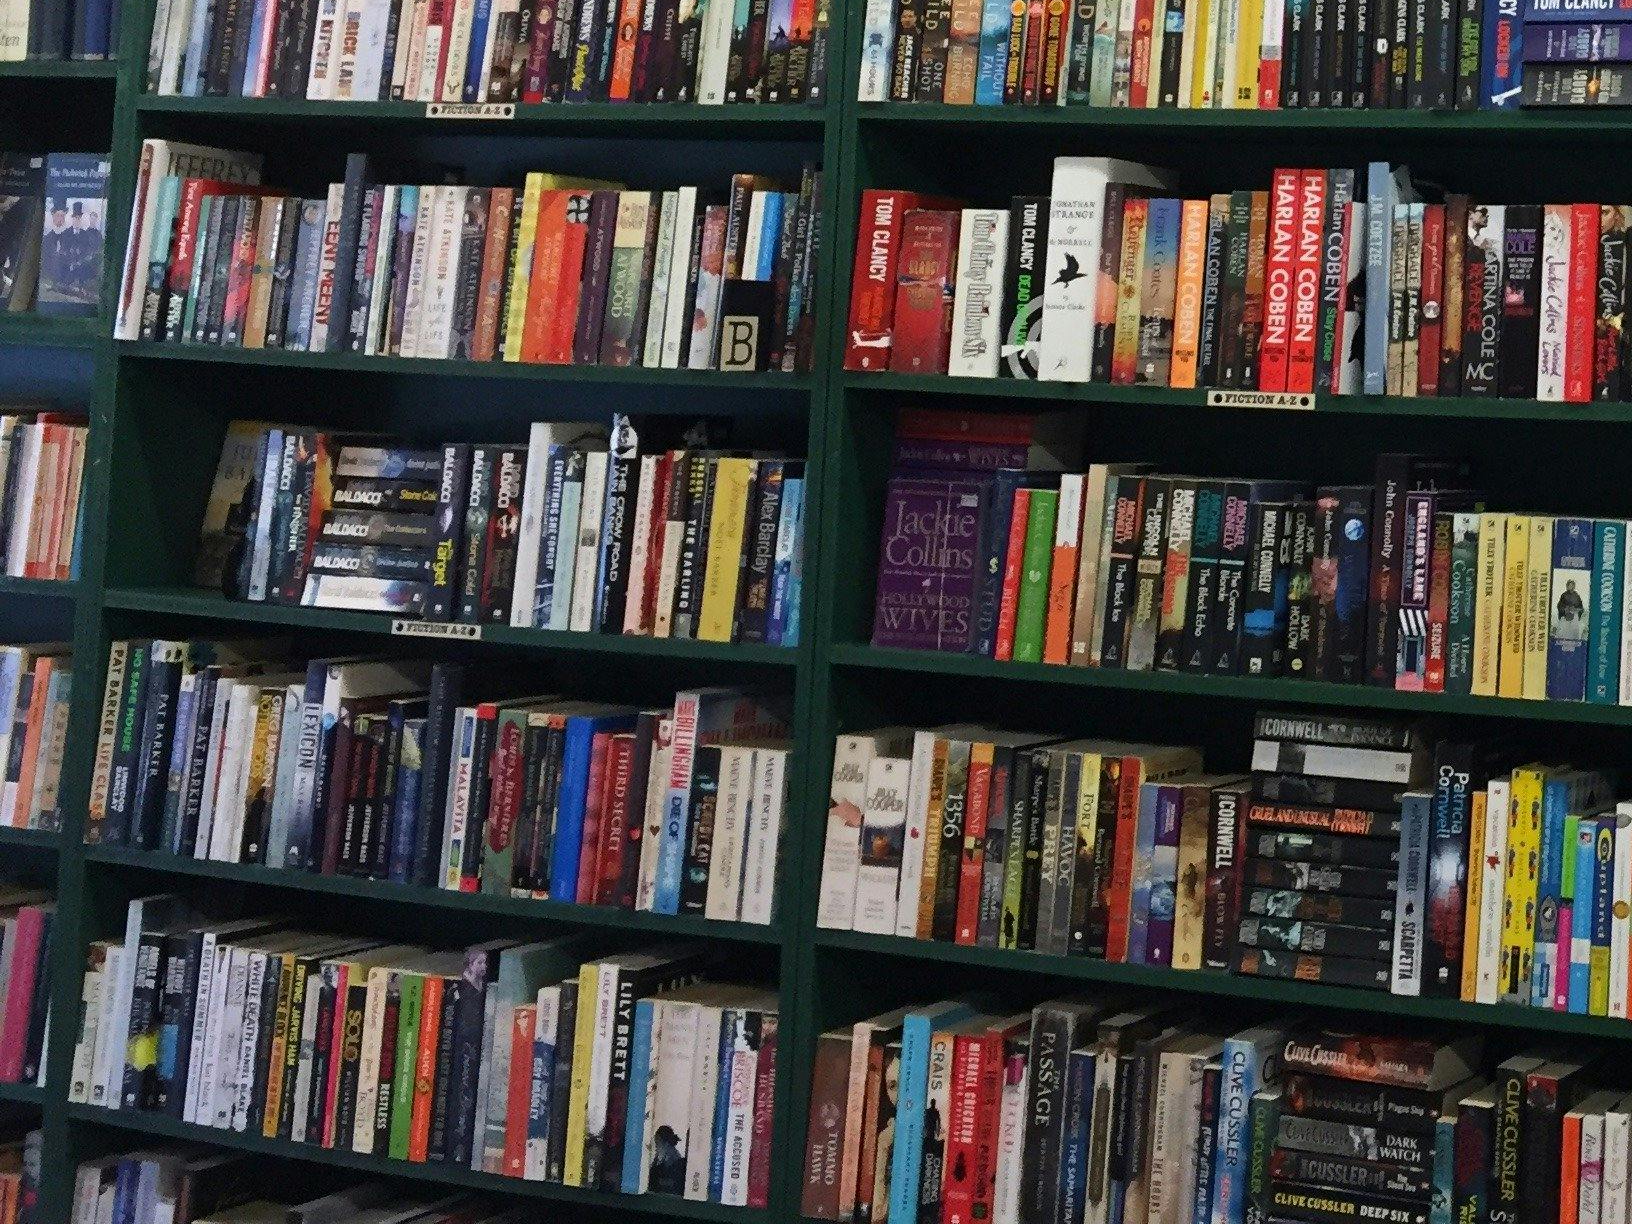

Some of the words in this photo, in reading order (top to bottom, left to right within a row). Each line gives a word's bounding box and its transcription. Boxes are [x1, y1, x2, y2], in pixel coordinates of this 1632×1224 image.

[876, 196, 894, 221] TOM
[1272, 175, 1296, 263] HARLAN
[1299, 176, 1322, 263] HARLAN
[869, 224, 891, 283] CLANCY
[1266, 268, 1289, 345] COBEN
[1294, 268, 1316, 342] COBEN
[725, 321, 753, 366] B
[1225, 392, 1273, 406] FICTION
[1278, 395, 1298, 406] A-Z
[334, 490, 381, 504] BALDACCI
[895, 500, 975, 538] Jackie
[322, 523, 369, 538] BALDACCI
[885, 534, 974, 570] Collins
[879, 609, 969, 634] WIVES
[299, 703, 321, 768] LEXICON
[943, 794, 963, 838] 1356
[618, 982, 633, 1024] LILY
[613, 1031, 628, 1081] BRETT
[1234, 1052, 1246, 1089] CLIVE
[1034, 1031, 1056, 1128] PASSAGE
[1227, 1091, 1245, 1167] CUSSLER
